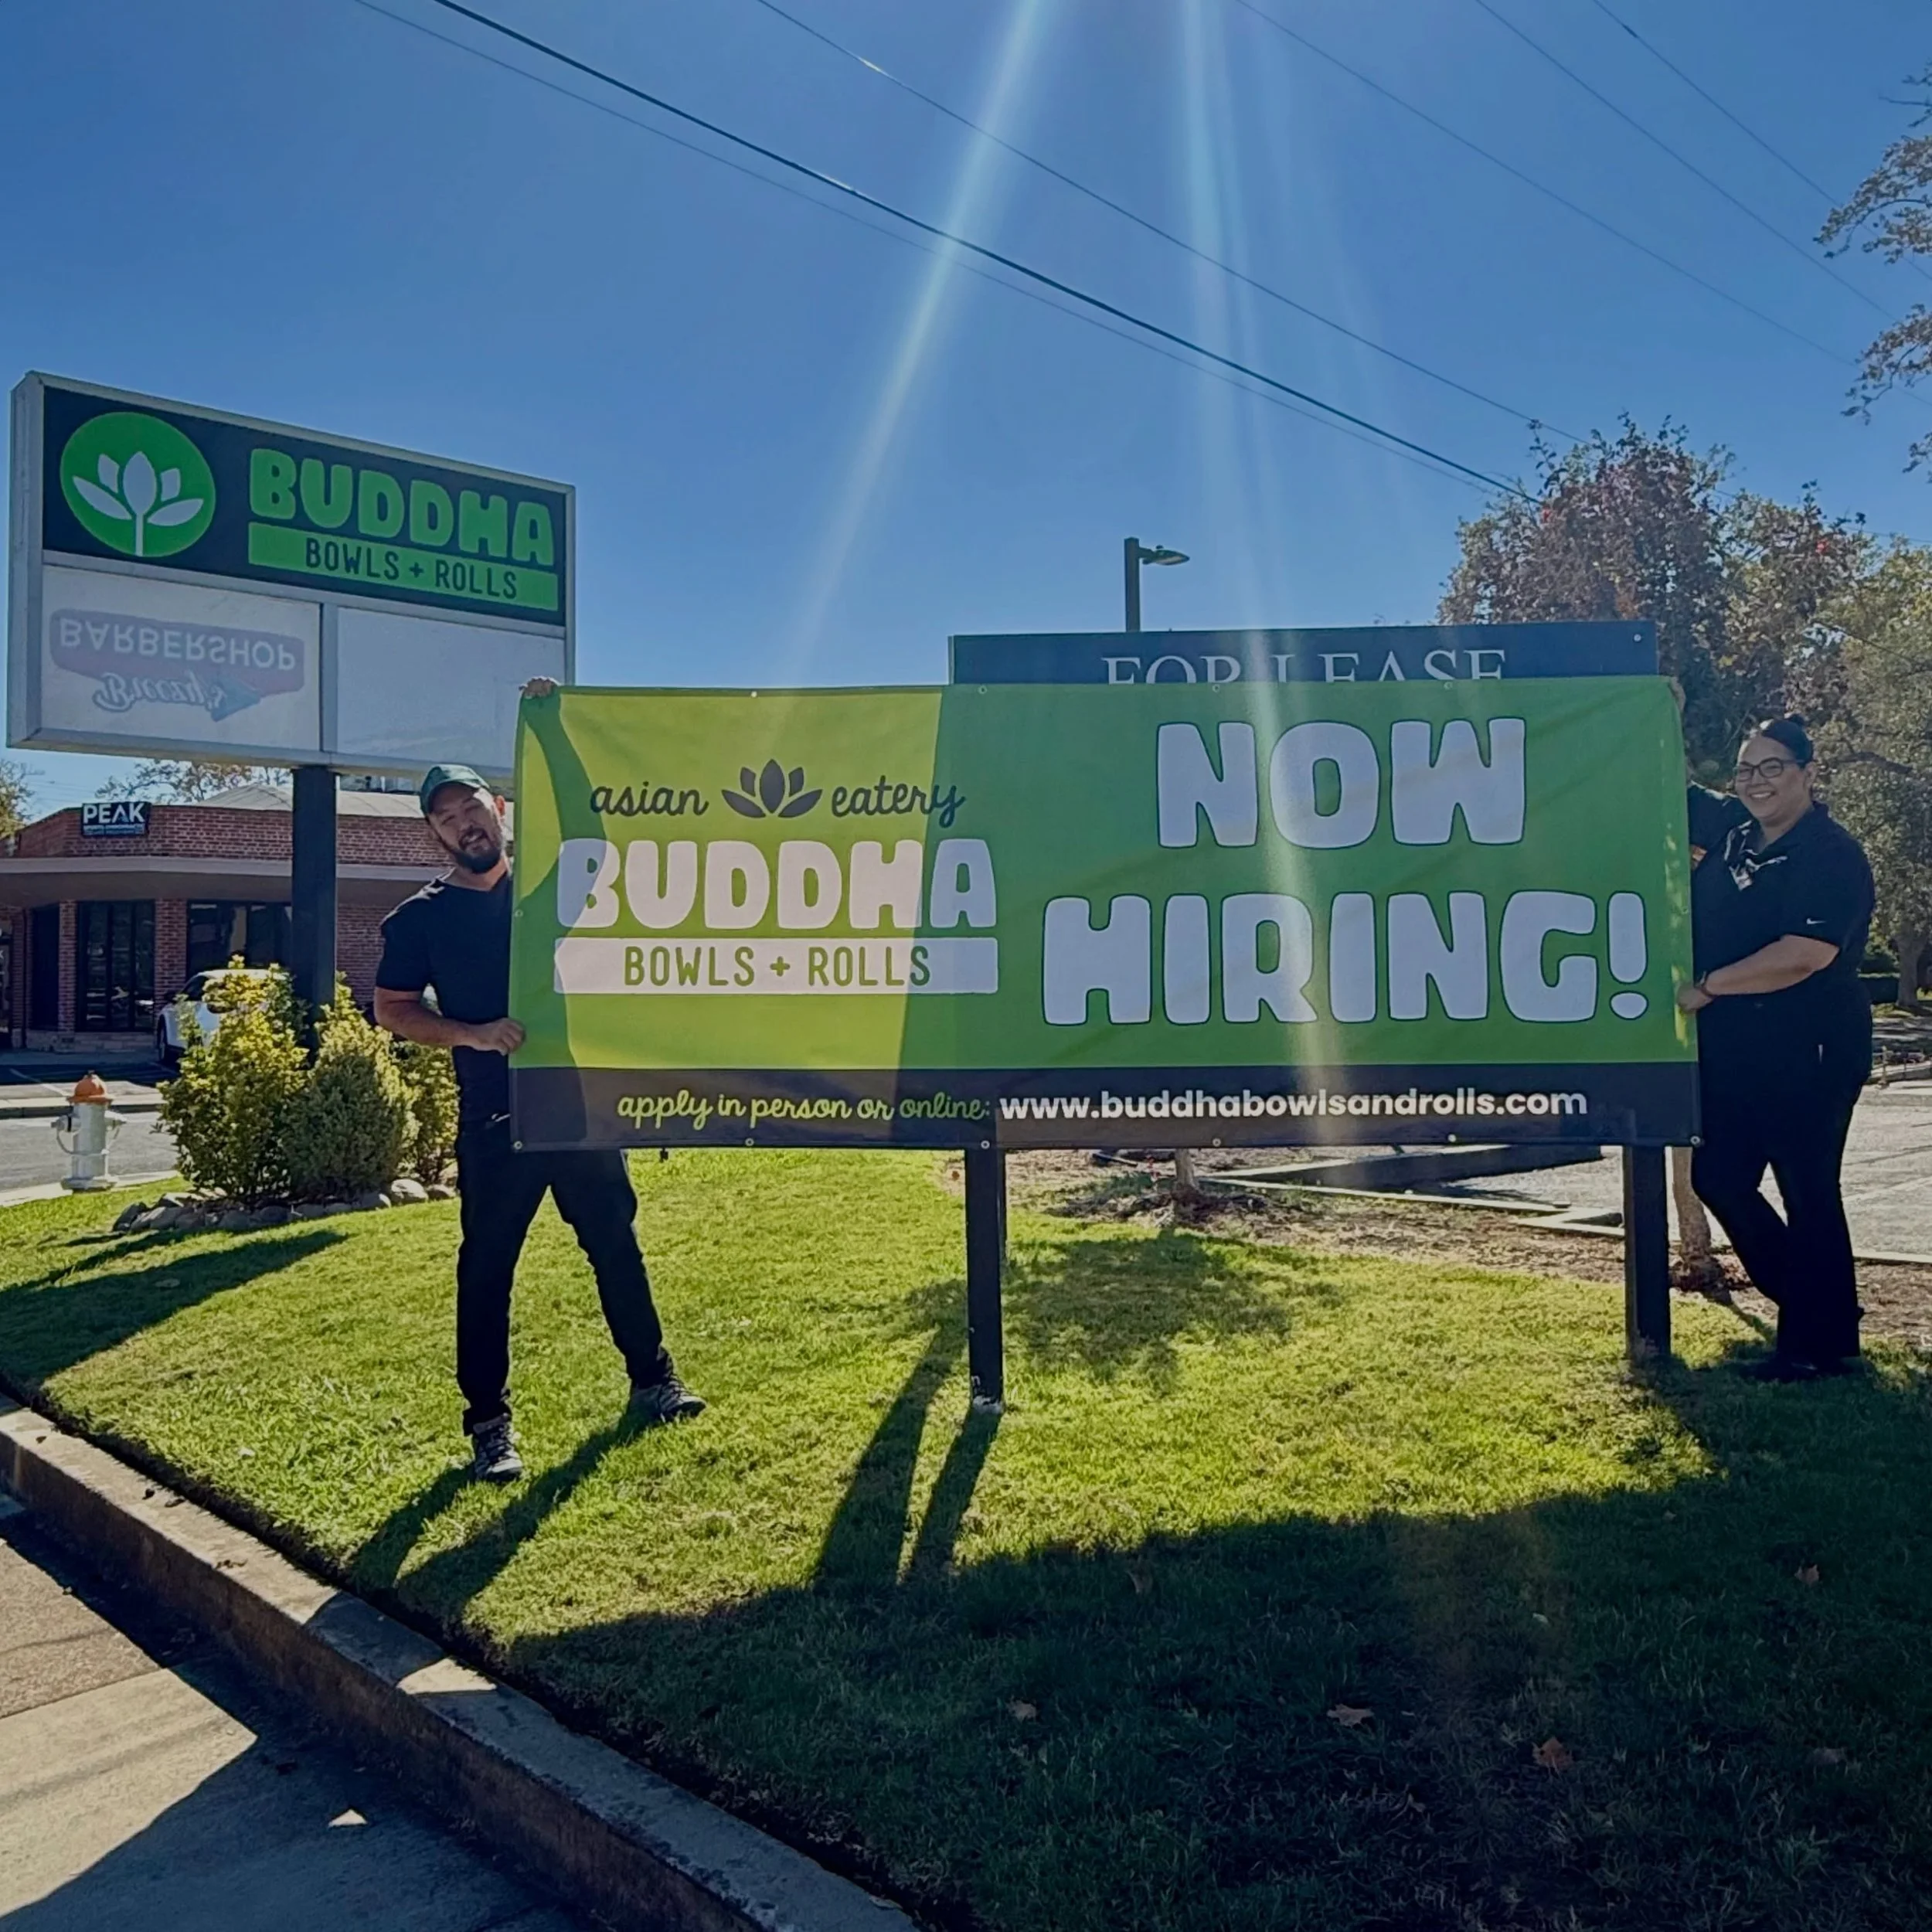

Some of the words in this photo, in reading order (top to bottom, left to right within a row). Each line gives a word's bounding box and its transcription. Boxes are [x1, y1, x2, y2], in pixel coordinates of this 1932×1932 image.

[250, 447, 555, 566] BUDDHA
[306, 537, 400, 581] BOWLS
[435, 559, 517, 600] ROLLS
[83, 802, 145, 825] PEAK
[590, 781, 709, 816] asian
[832, 775, 965, 828] eatery
[1156, 717, 1526, 849] NOW
[557, 838, 996, 929] BUDDHA
[624, 946, 755, 987] BOWLS
[808, 946, 931, 987] ROLLS
[1043, 889, 1648, 1026] HIRING!
[617, 1090, 712, 1130] apply
[718, 1094, 747, 1117] in
[750, 1097, 852, 1128] person
[856, 1097, 894, 1121] or
[899, 1092, 991, 1120] online:
[999, 1089, 1588, 1121] www.buddhabowlsandrolls.com
